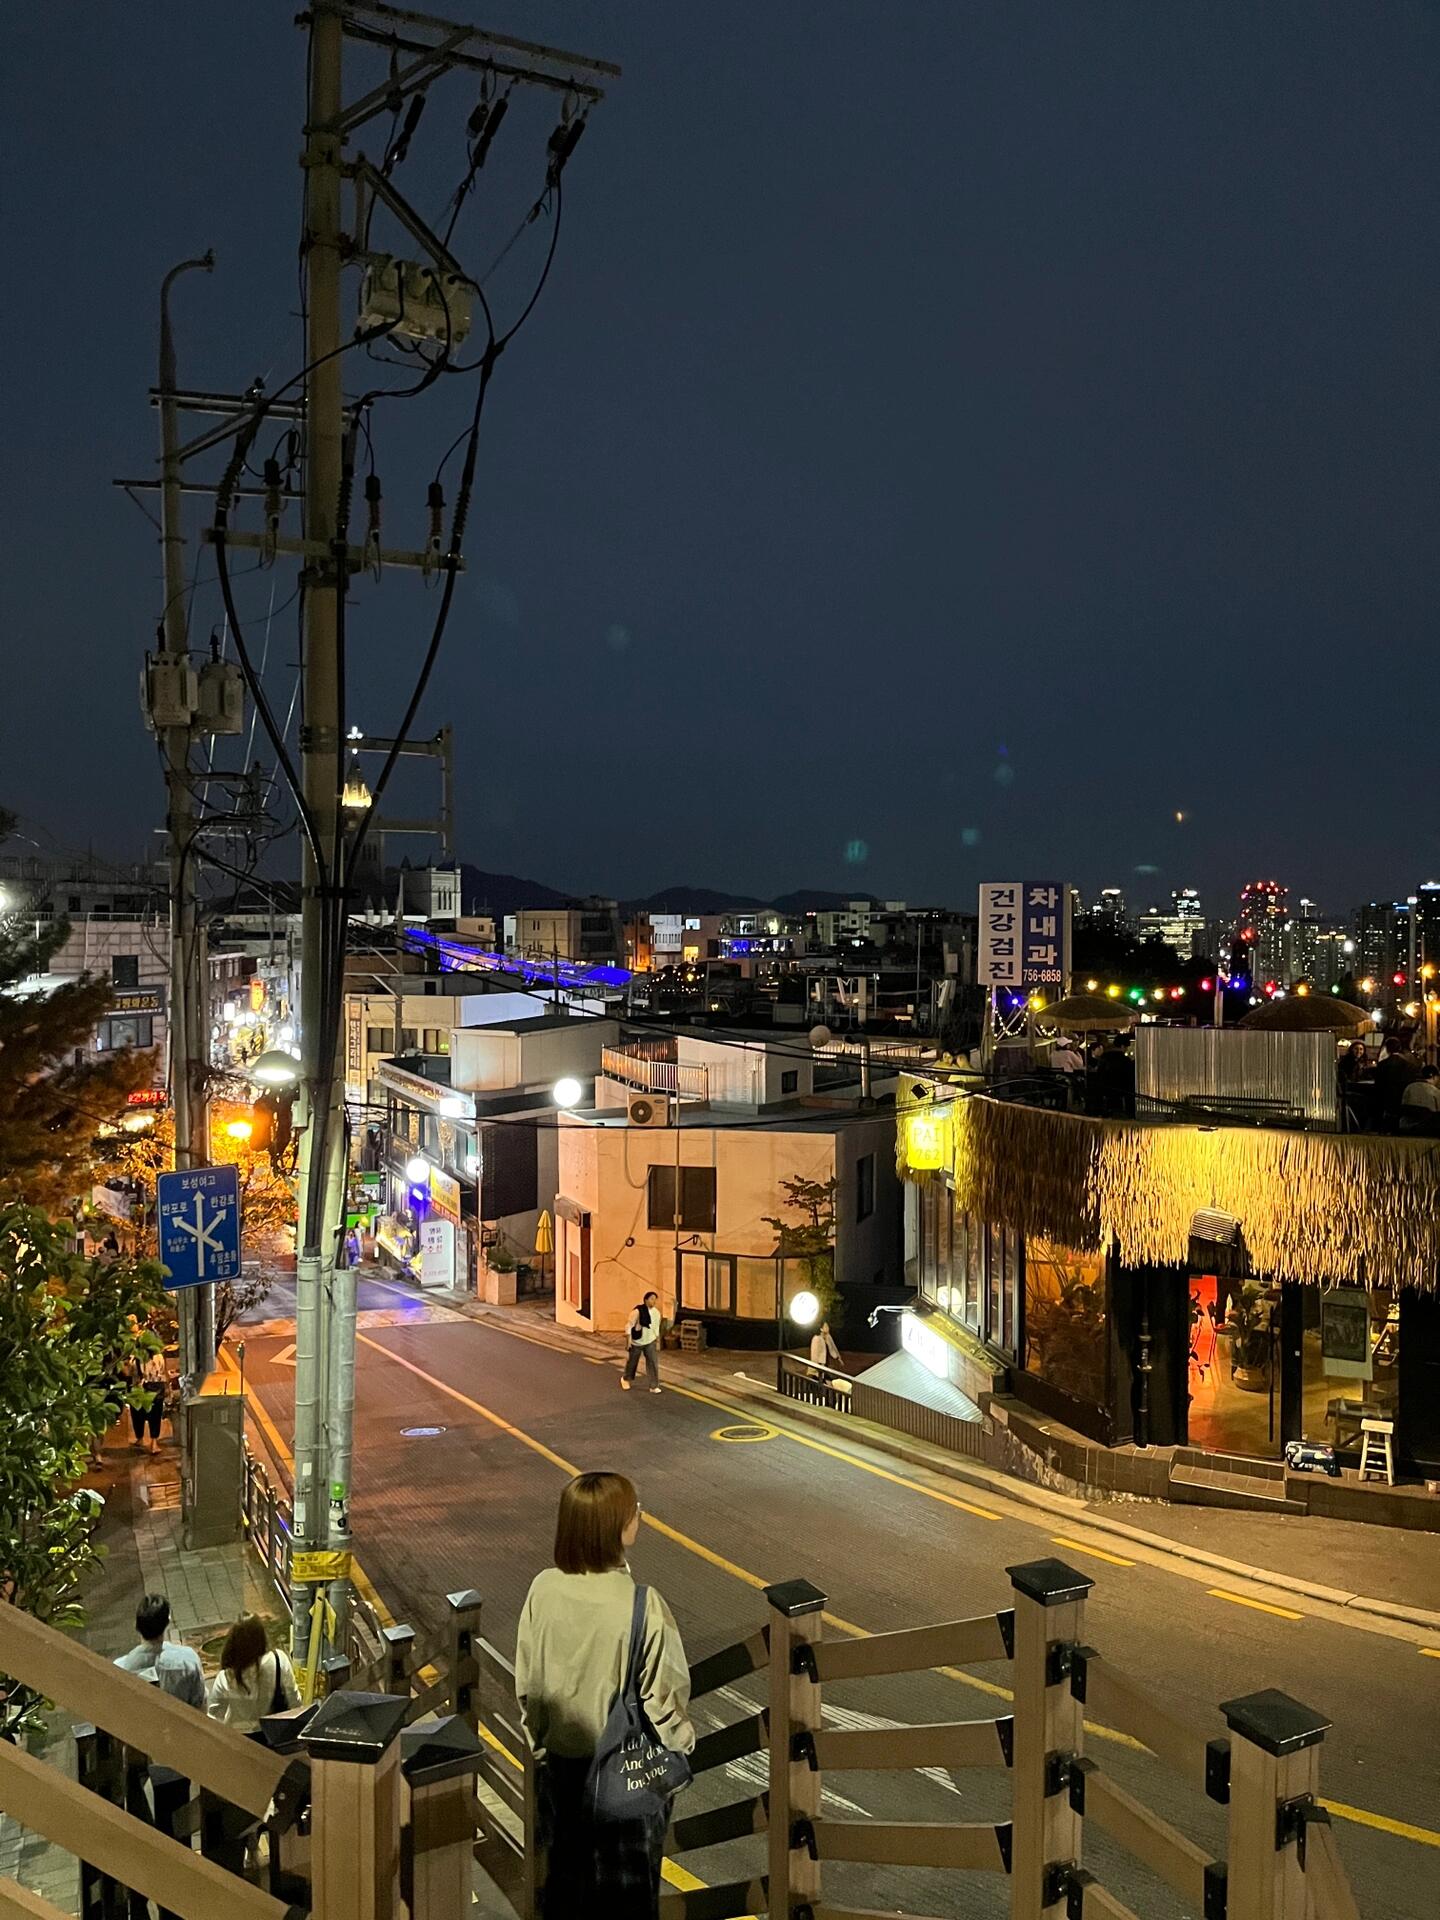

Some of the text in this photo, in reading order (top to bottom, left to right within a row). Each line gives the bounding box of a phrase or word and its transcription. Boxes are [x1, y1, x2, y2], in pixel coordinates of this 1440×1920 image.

[988, 888, 1016, 980] 건강검진
[1027, 887, 1059, 966] 차내과
[1023, 968, 1062, 983] 756-6858
[913, 1127, 940, 1144] PAI
[915, 1149, 940, 1161] 762
[181, 1175, 216, 1190] 보성여고
[210, 1194, 236, 1208] 한강로
[161, 1202, 189, 1216] 반포로
